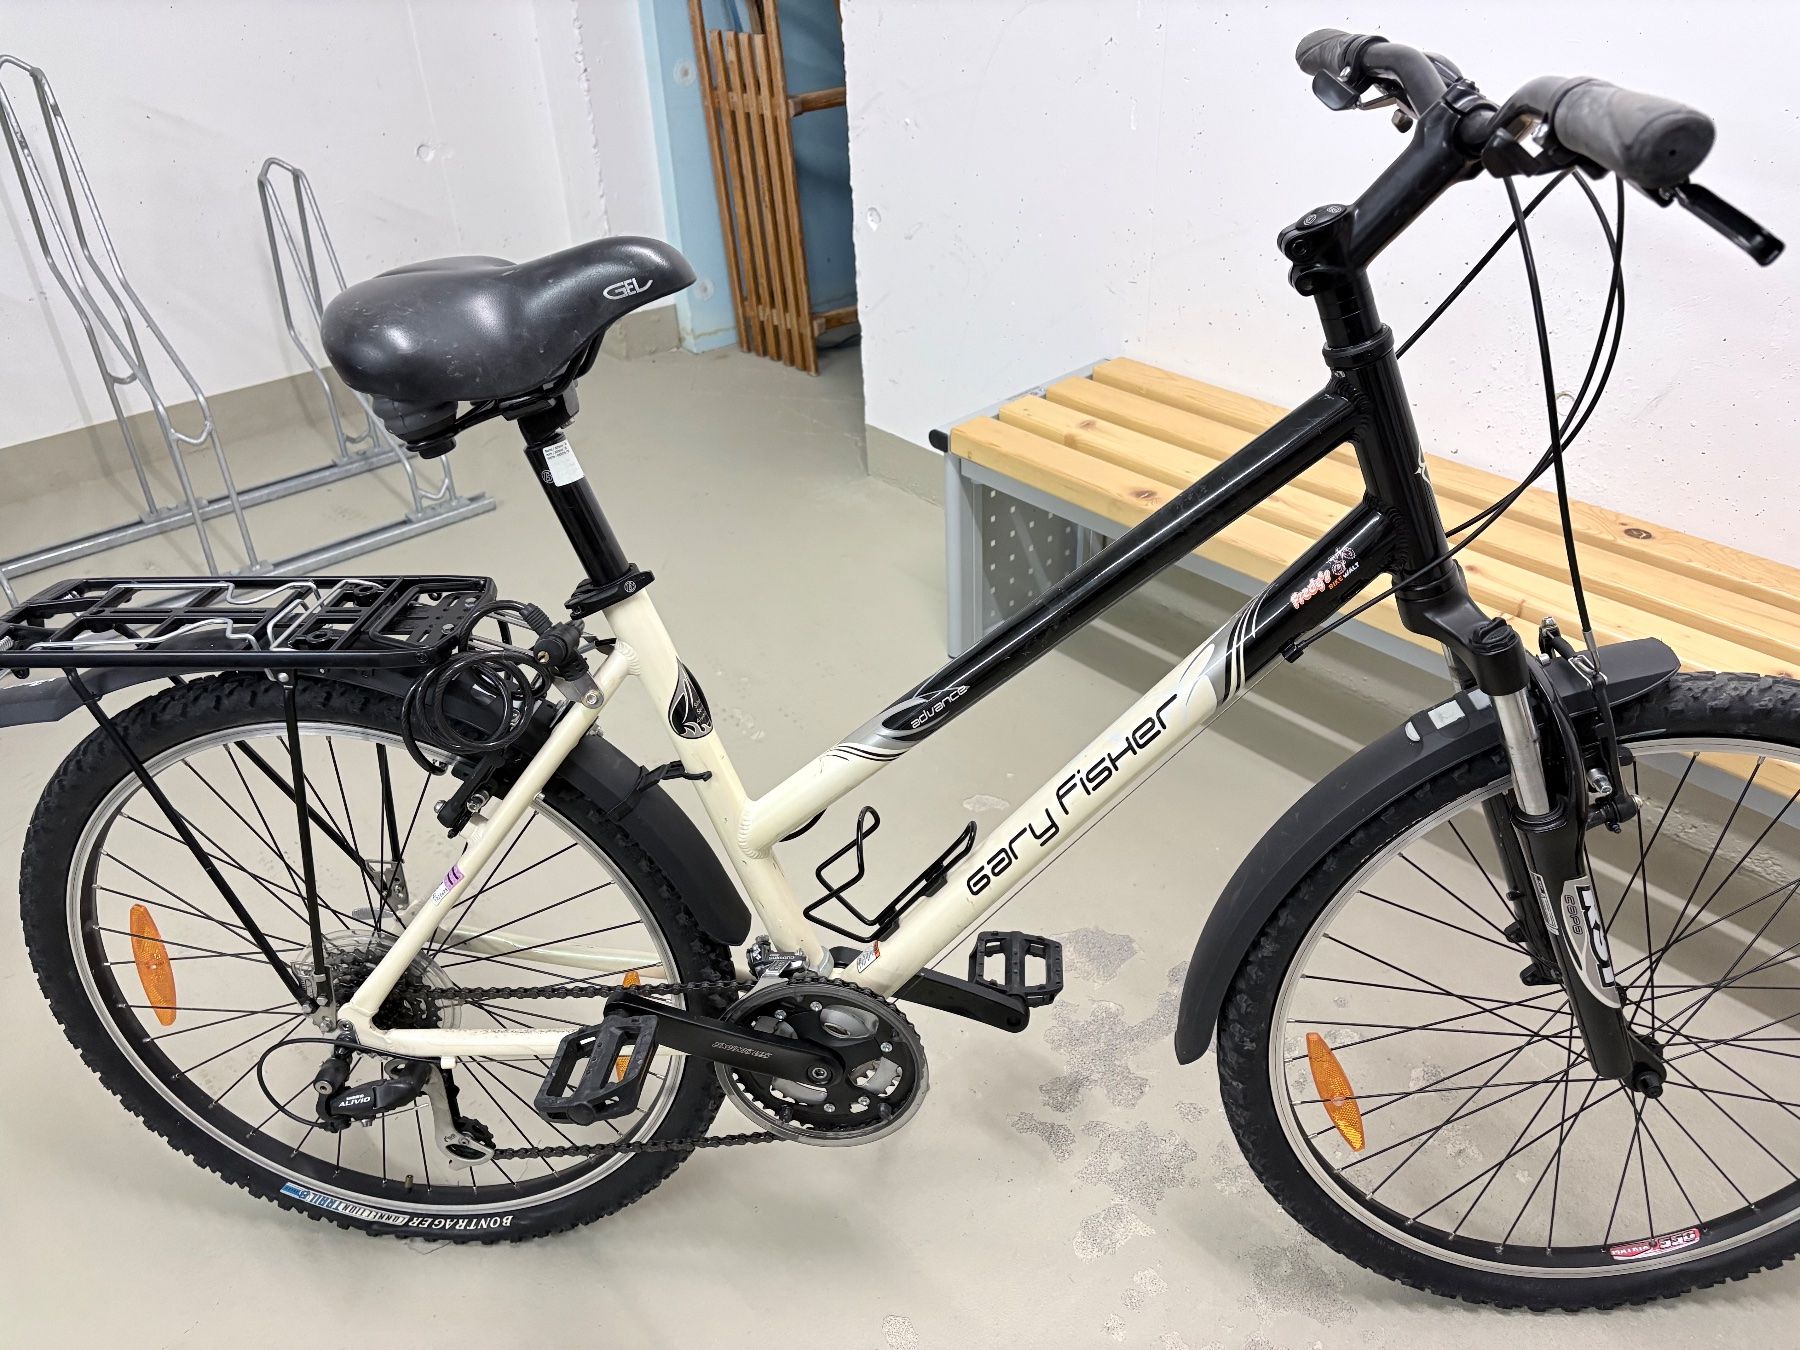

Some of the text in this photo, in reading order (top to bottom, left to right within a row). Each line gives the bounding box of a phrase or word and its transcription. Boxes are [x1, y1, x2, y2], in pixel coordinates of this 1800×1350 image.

[603, 278, 653, 300] GEL
[910, 685, 969, 729] advance
[966, 808, 1060, 896] Gary
[338, 1096, 371, 1108] ALIVIO
[310, 1192, 342, 1211] TRAIL
[408, 1215, 514, 1231] BONTRAGER
